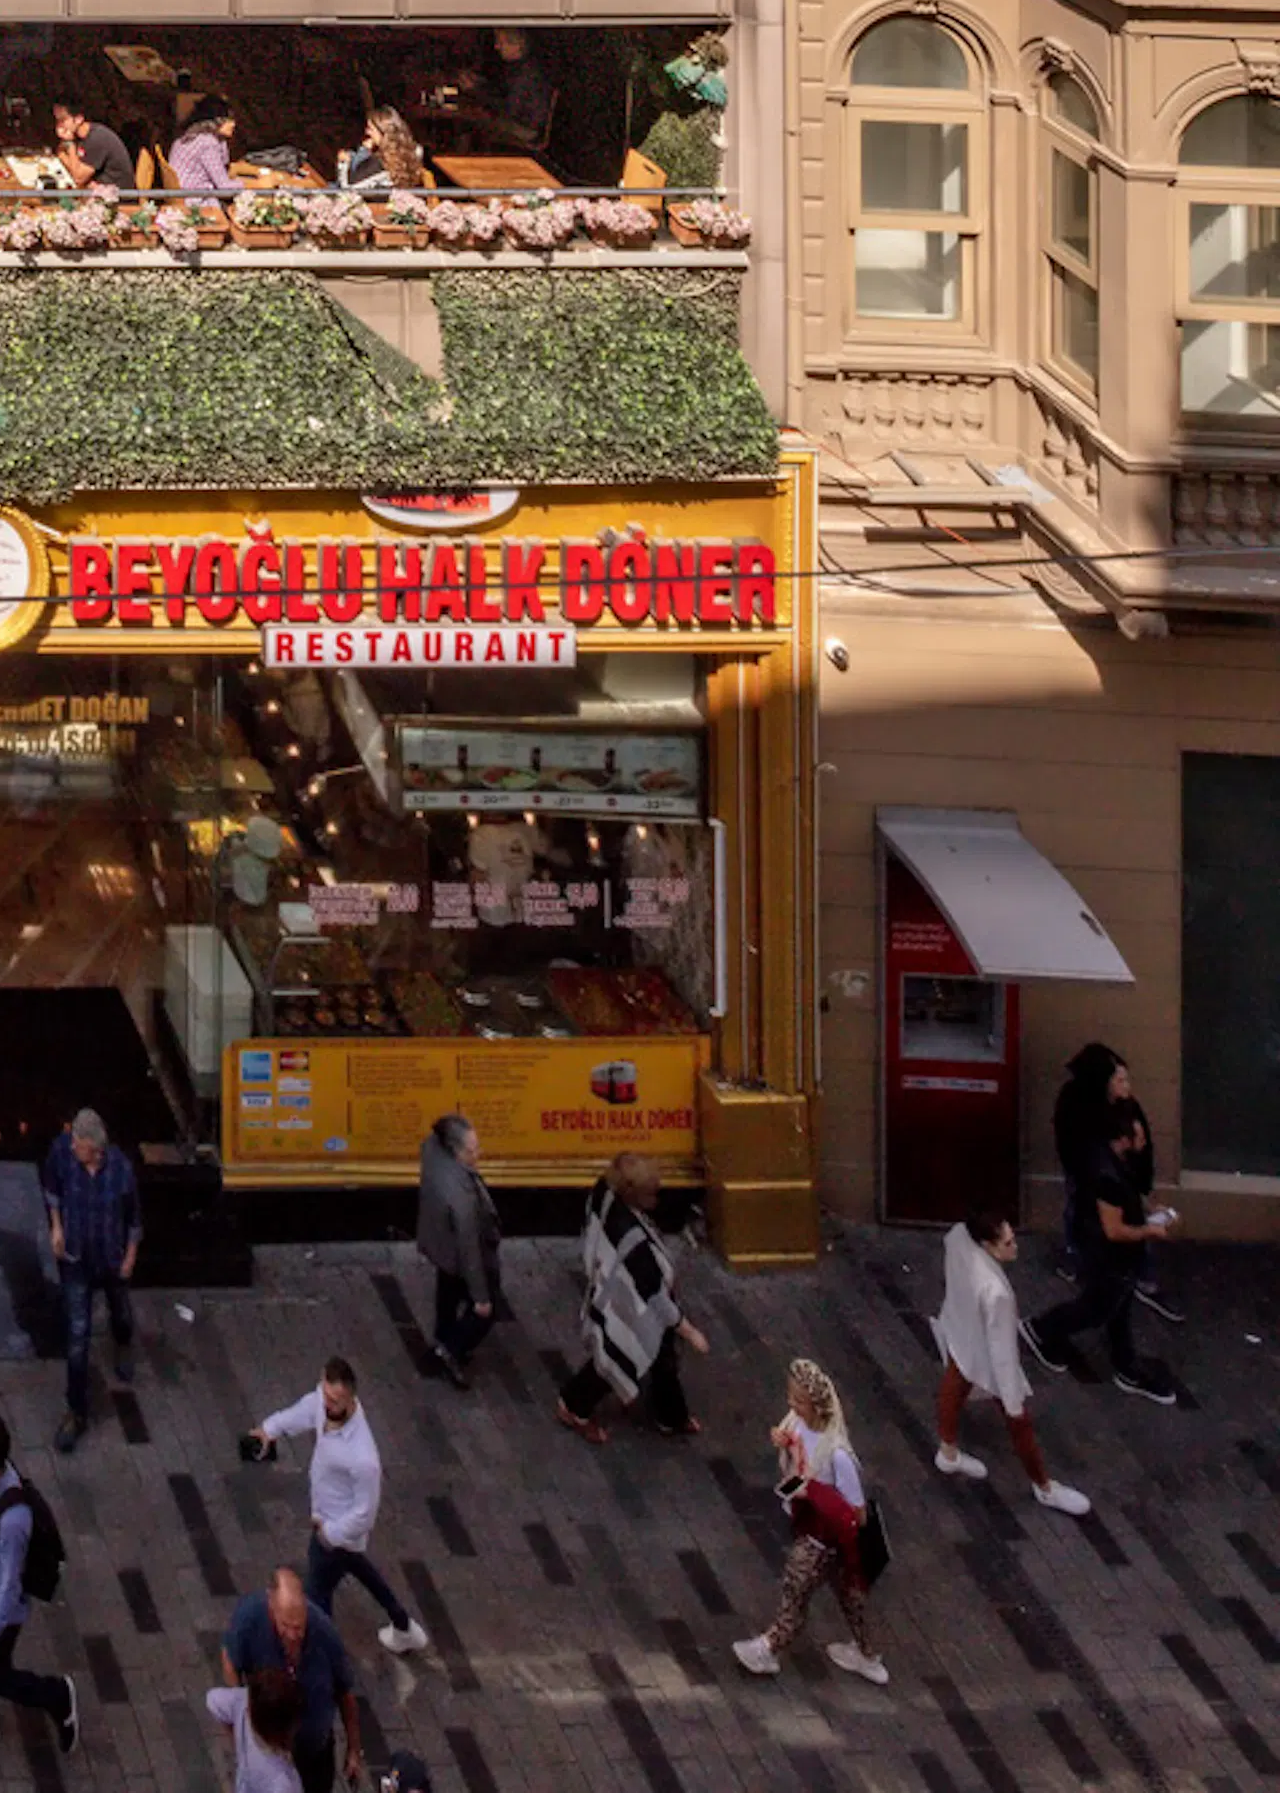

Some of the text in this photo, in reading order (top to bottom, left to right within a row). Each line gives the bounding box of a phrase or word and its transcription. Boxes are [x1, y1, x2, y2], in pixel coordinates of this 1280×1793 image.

[70, 519, 776, 623] BEYOĞLU HALK DÖNER
[276, 632, 566, 662] RESTAURANT
